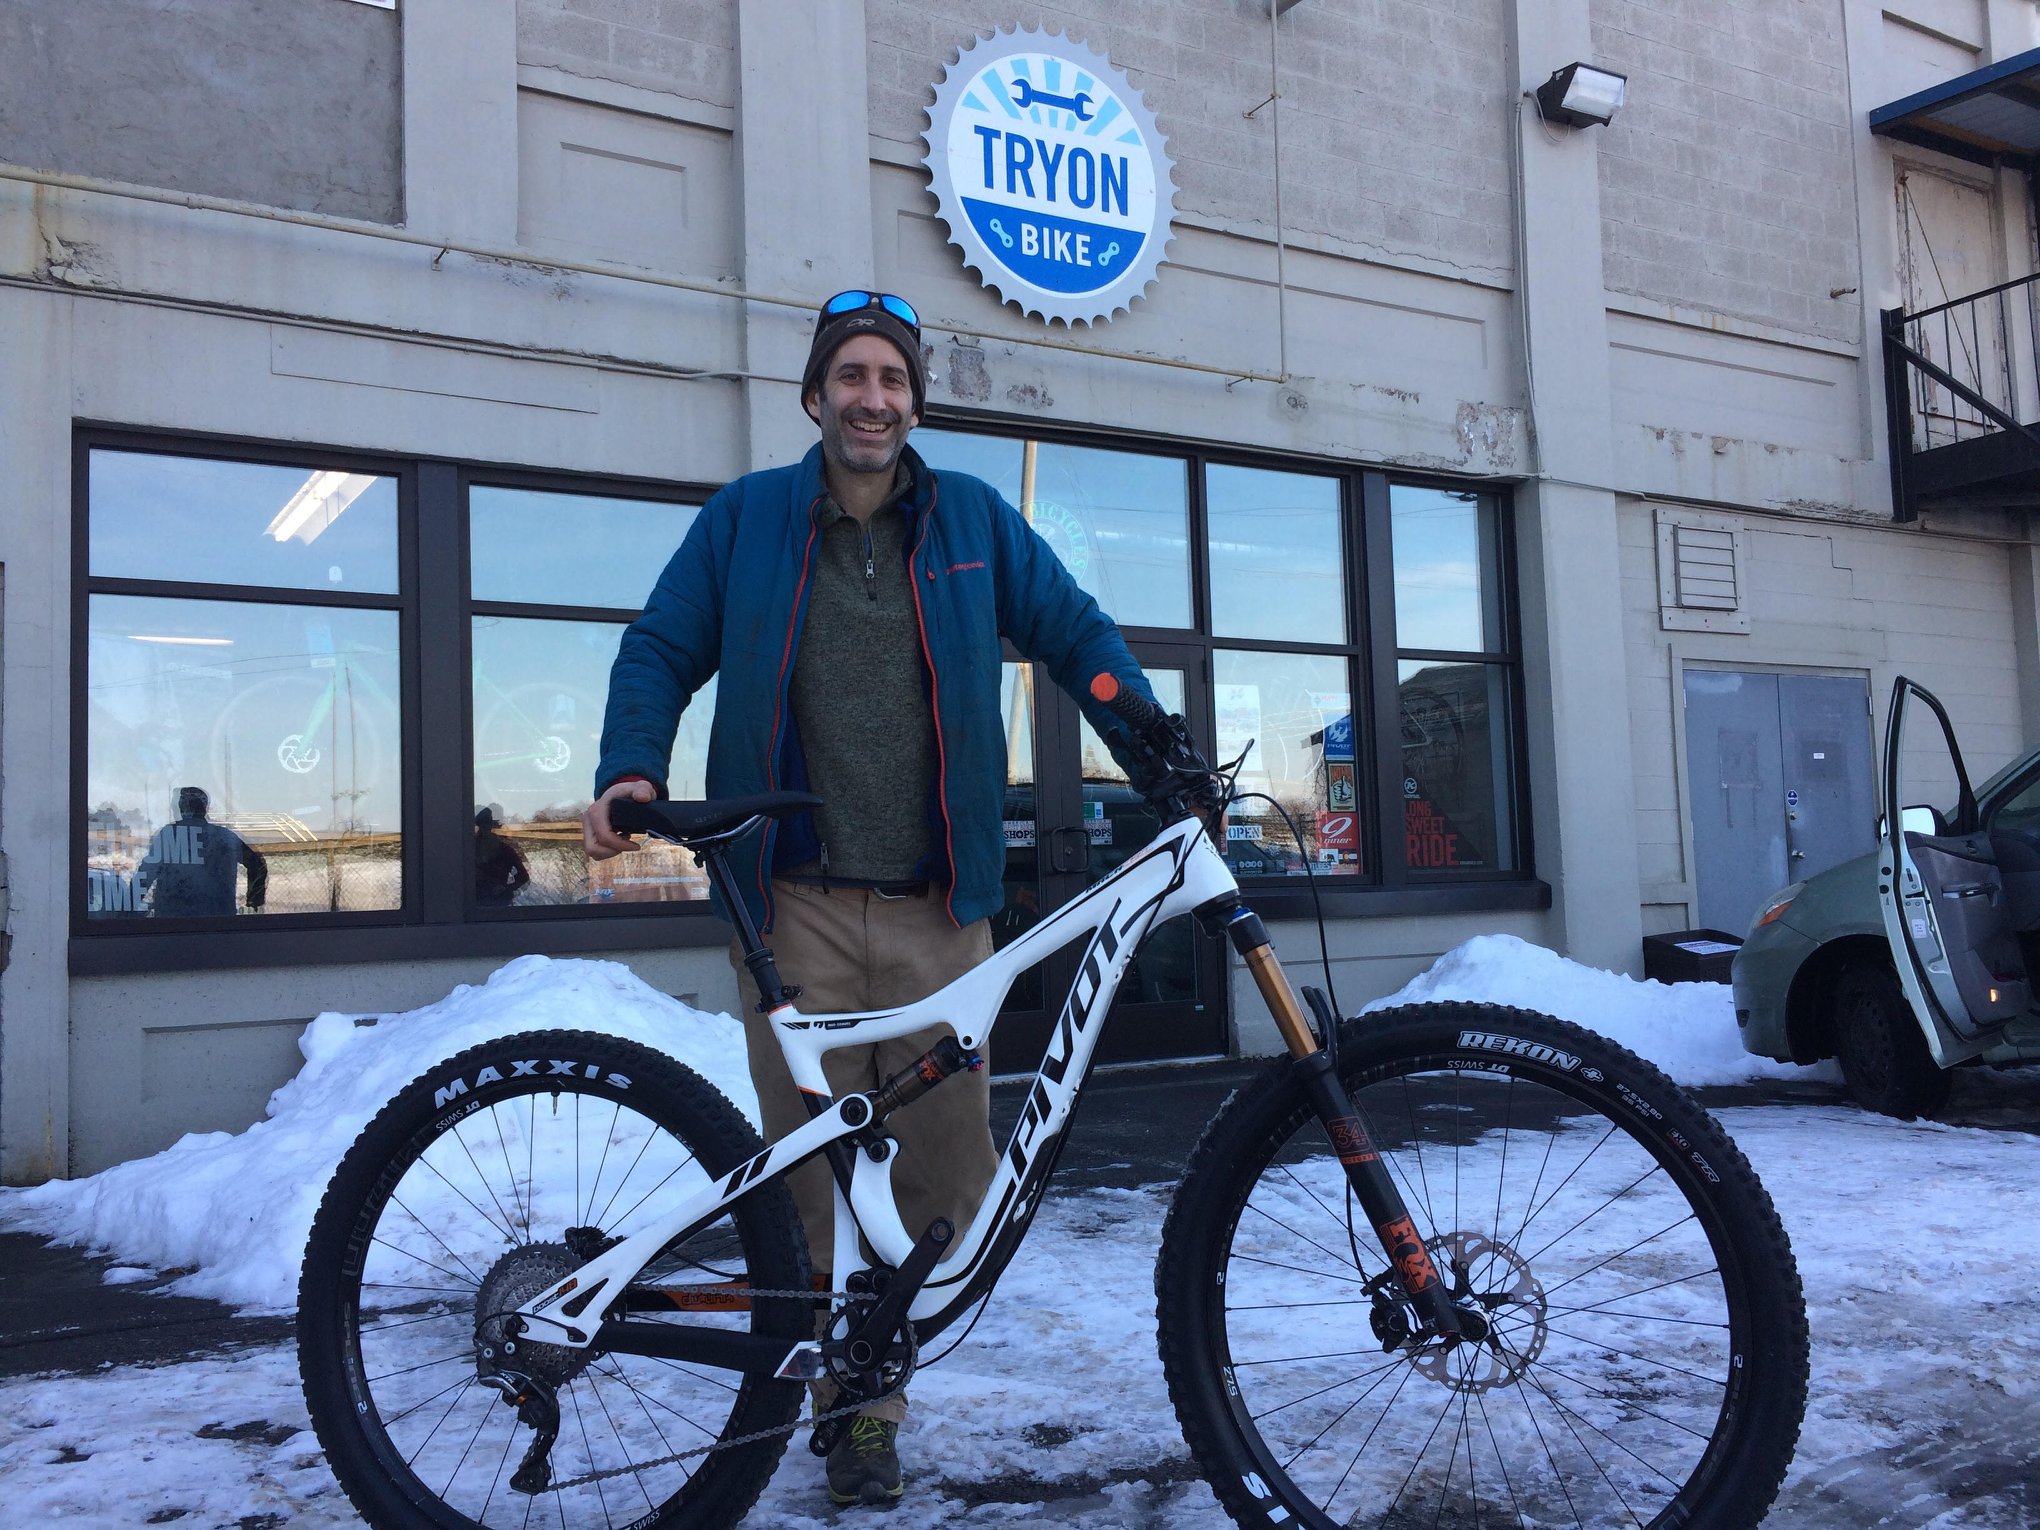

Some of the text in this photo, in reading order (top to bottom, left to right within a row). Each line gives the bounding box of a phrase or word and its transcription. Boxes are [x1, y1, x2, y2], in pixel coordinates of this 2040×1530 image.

[974, 124, 1129, 217] TRYON
[1020, 223, 1092, 267] BIKE
[1405, 800, 1432, 817] LONG
[1003, 830, 1035, 839] SHOPS
[1089, 828, 1113, 838] HOPS
[1228, 827, 1261, 839] OPEN
[1405, 817, 1445, 834] SWEET
[1406, 834, 1458, 867] RIDE
[1009, 897, 1122, 1181] PIVOT
[1456, 1031, 1582, 1073] REKON
[1447, 1060, 1511, 1074] DT SWISS
[434, 1059, 633, 1110] MAXXIS
[436, 1100, 481, 1132] DT SWISS
[1333, 1120, 1369, 1149] 34
[1386, 1215, 1440, 1292] FOX
